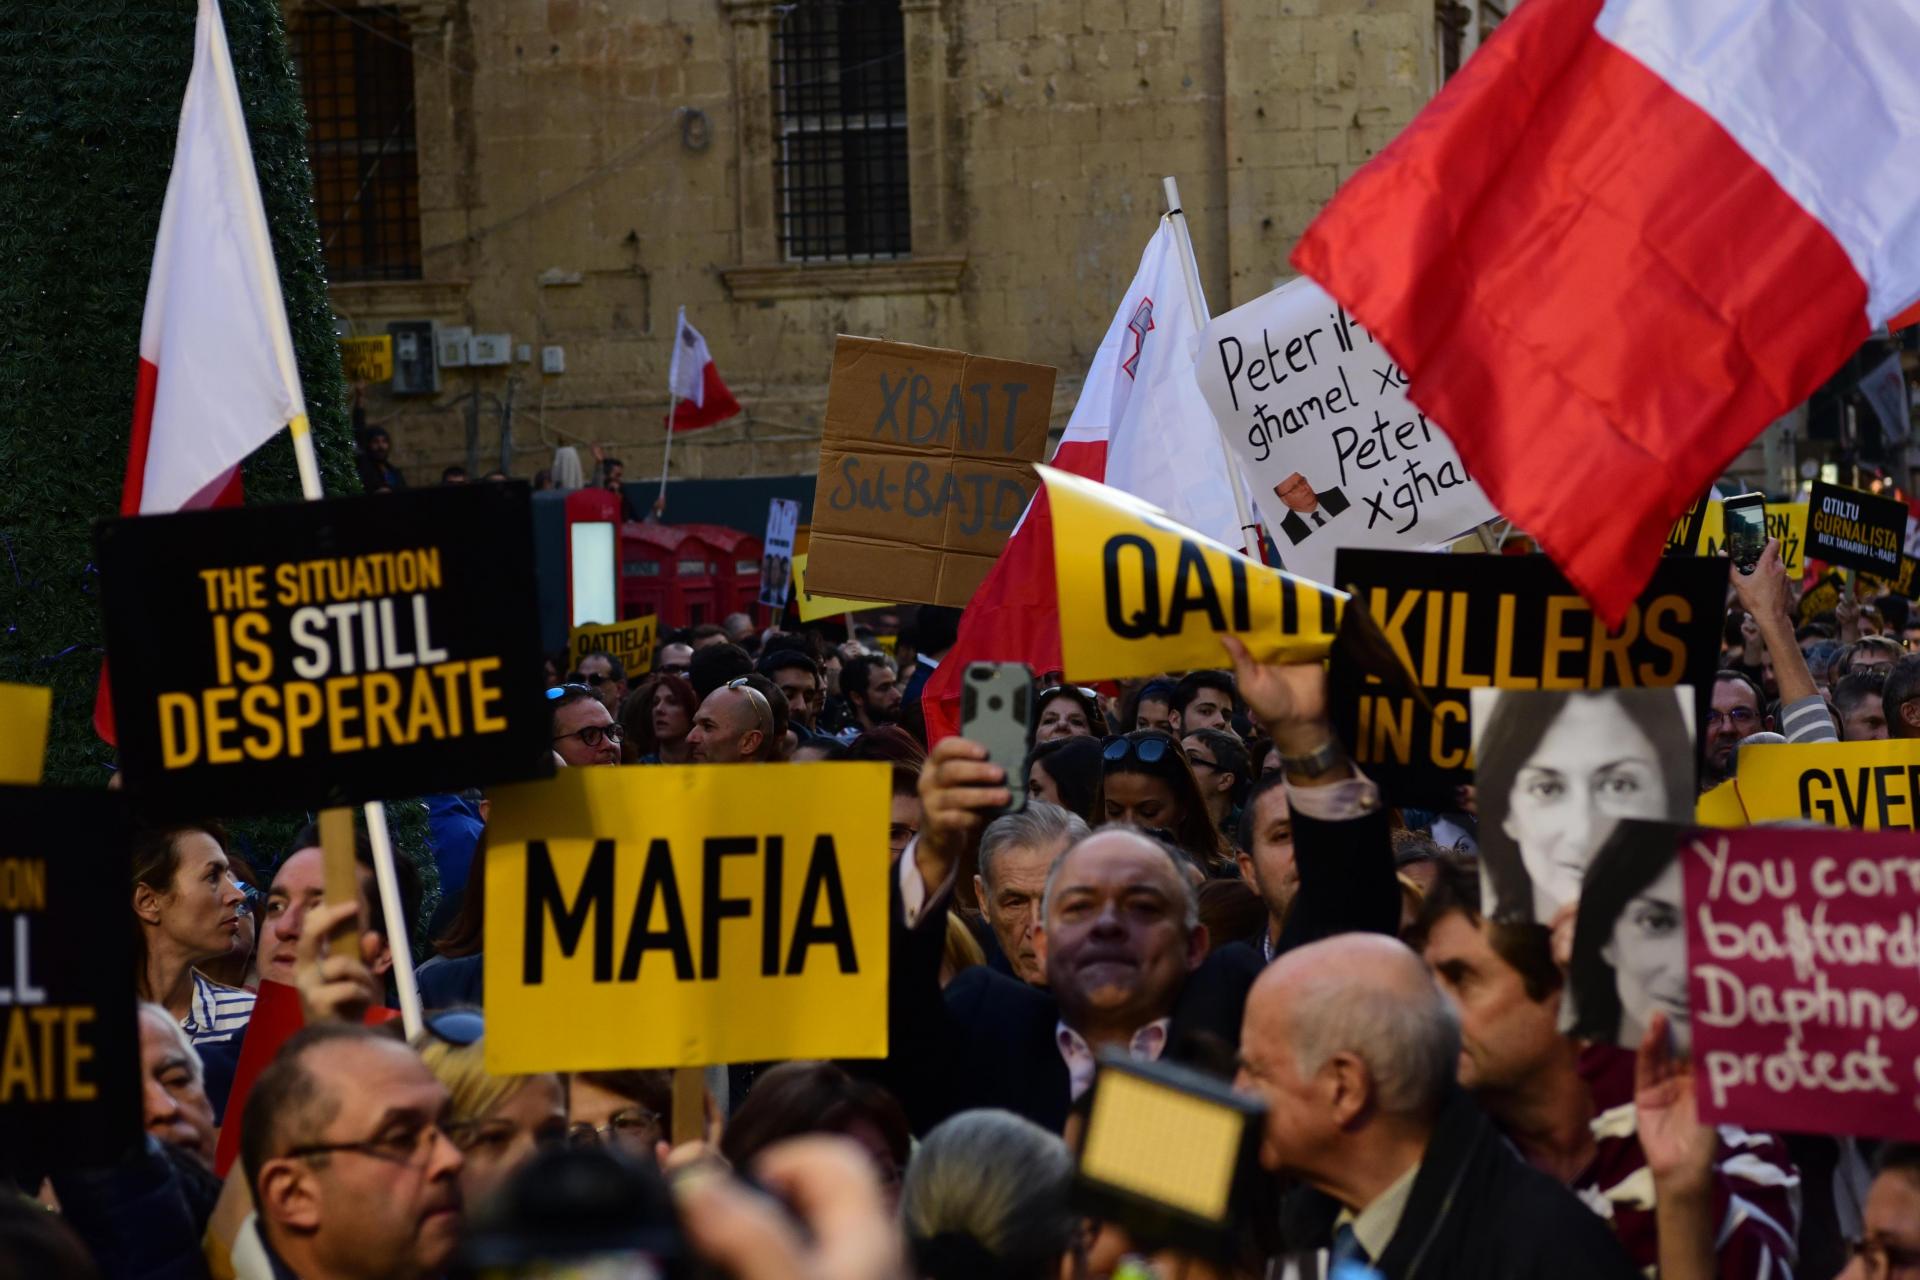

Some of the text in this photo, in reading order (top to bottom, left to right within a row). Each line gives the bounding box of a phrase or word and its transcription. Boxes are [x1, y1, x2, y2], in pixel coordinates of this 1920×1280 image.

[1217, 300, 1373, 412] Peter il-
[1361, 458, 1472, 534] x'għa
[1822, 495, 1860, 521] QTILTU
[199, 547, 442, 612] THE SITUATION
[213, 594, 449, 687] IS STILL
[1366, 586, 1693, 690] KILLERS
[157, 656, 508, 771] DESPERATE
[1356, 695, 1473, 771] IN C
[523, 833, 860, 986] MAFIA
[1692, 837, 1797, 906] You
[1694, 963, 1919, 1041] Daphne
[0, 1005, 98, 1099] ATE
[1704, 1035, 1899, 1109] protect
